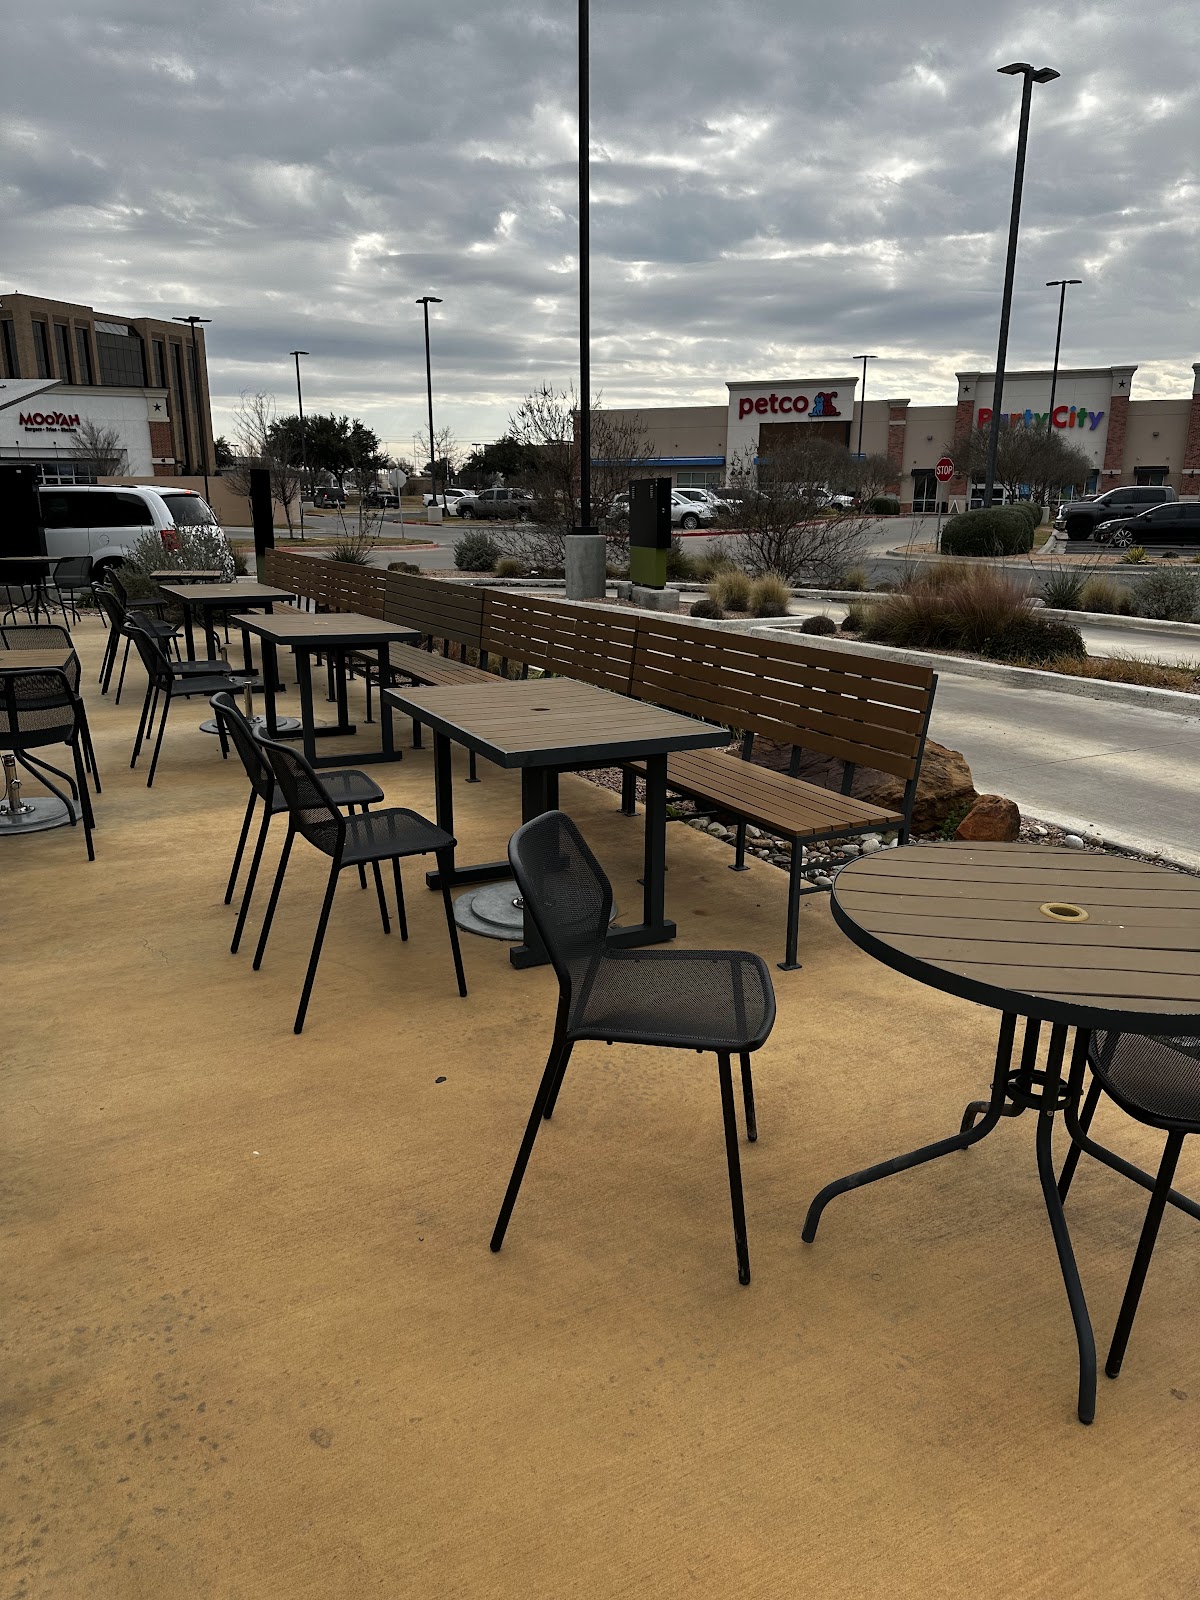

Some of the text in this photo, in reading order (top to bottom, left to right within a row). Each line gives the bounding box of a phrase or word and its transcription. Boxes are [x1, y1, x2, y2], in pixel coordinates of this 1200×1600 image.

[738, 393, 809, 420] petco
[19, 411, 80, 426] MOOYAH
[1052, 405, 1105, 431] City
[936, 465, 953, 475] STOP
